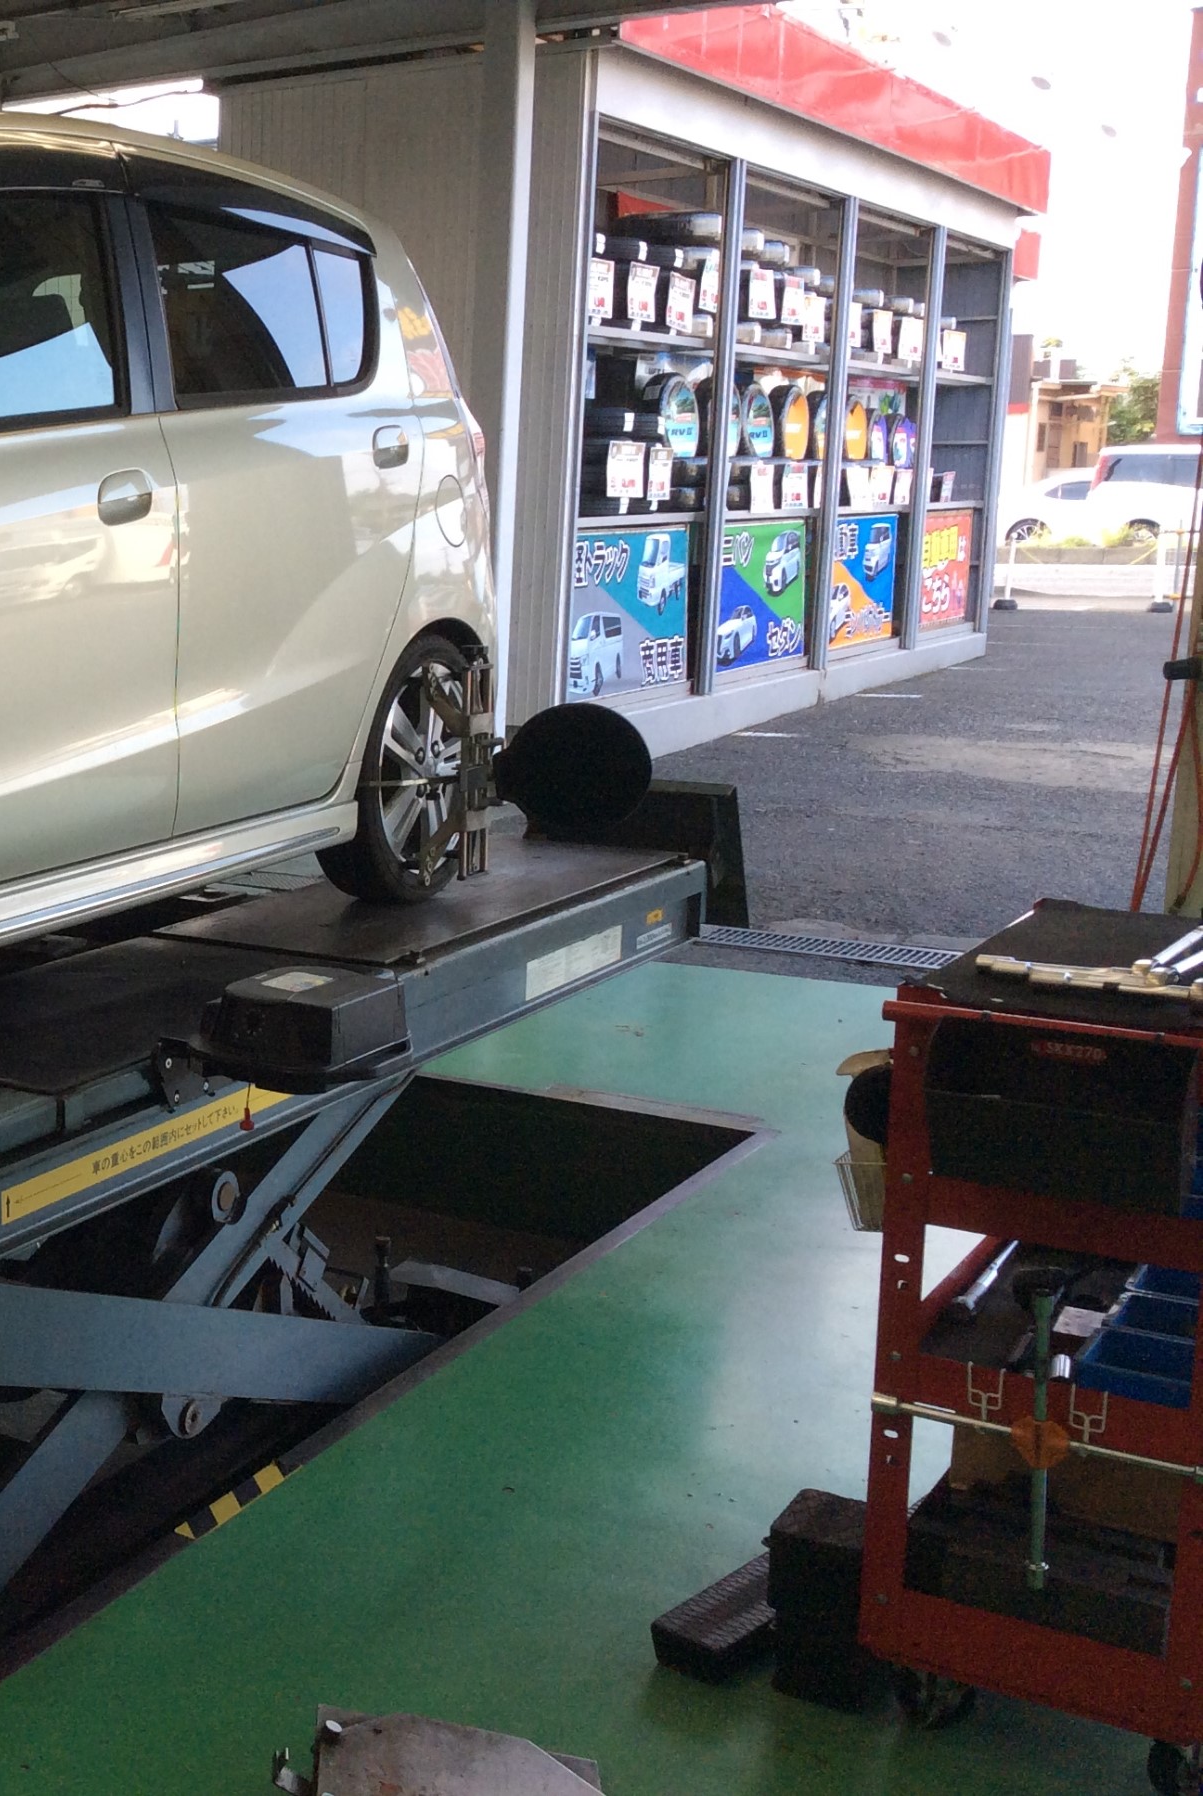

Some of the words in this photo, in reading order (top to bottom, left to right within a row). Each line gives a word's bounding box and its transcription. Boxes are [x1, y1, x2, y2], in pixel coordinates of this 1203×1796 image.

[721, 531, 755, 567] ニバン
[766, 616, 802, 657] セダン
[639, 635, 684, 686] 商用車
